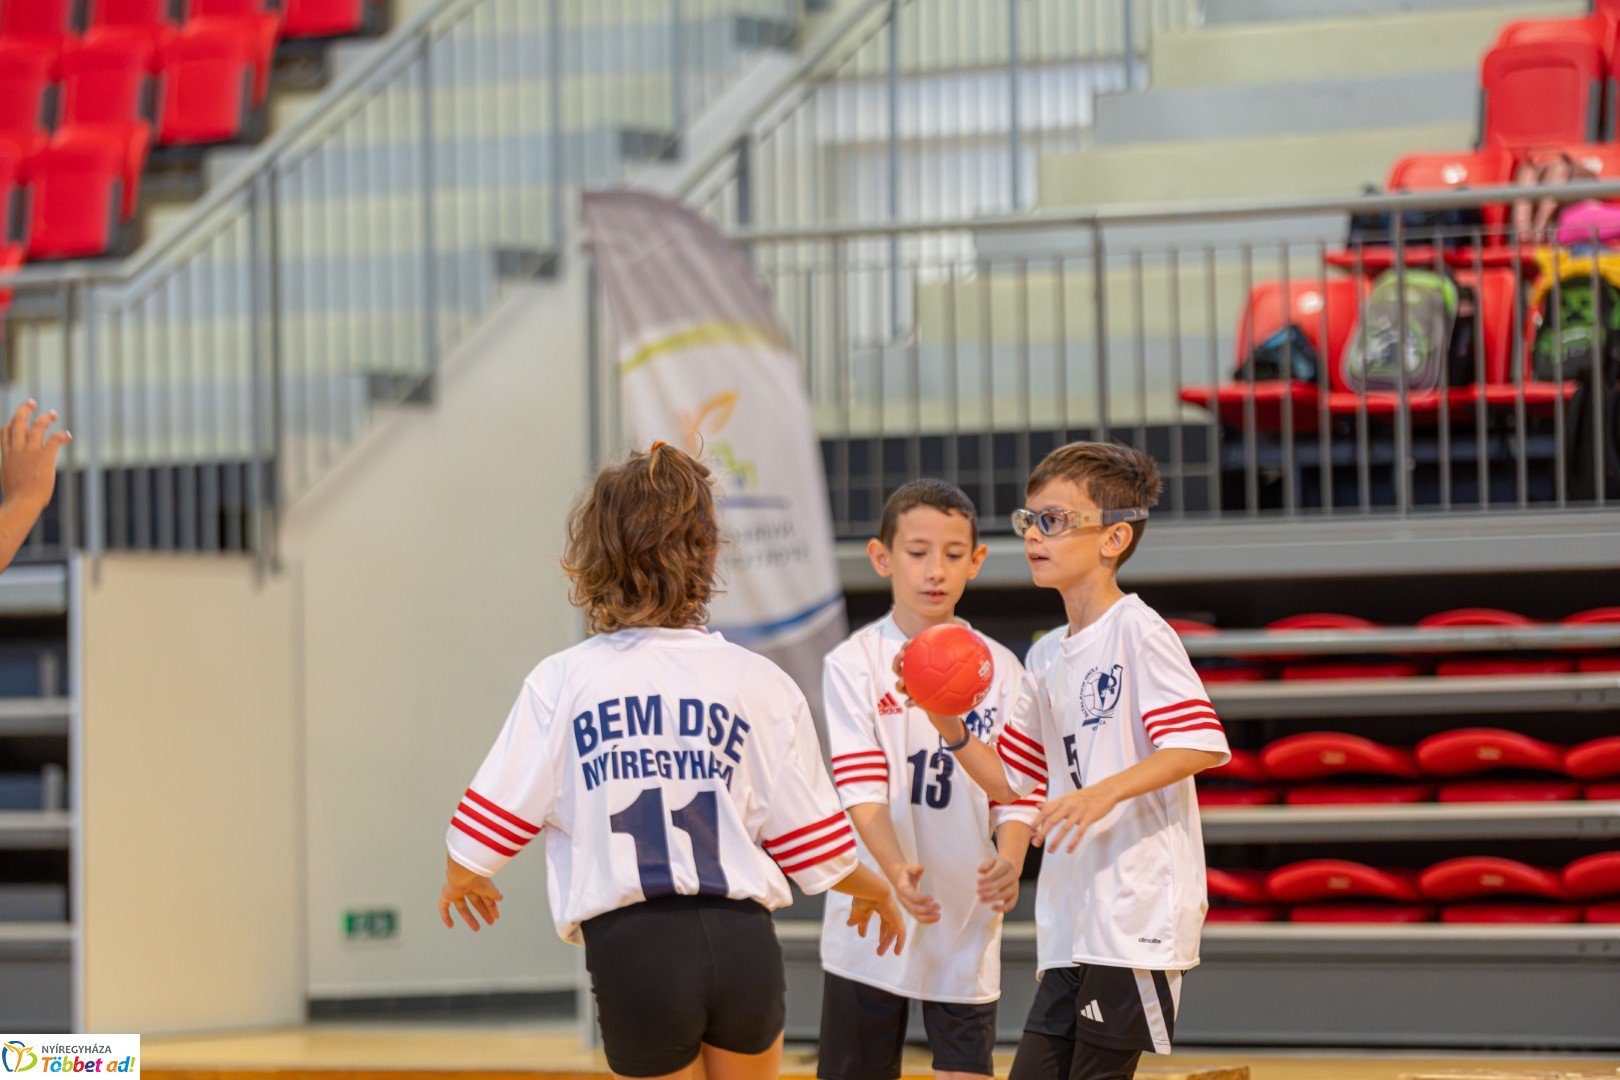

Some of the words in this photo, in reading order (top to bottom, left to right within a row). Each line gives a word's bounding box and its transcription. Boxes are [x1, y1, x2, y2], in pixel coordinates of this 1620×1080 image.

[573, 694, 663, 758] BEM
[679, 698, 751, 764] DSE
[878, 705, 903, 715] adidas
[581, 744, 734, 794] NYÍREGYHA
[906, 749, 954, 810] 13
[609, 787, 730, 900] 11
